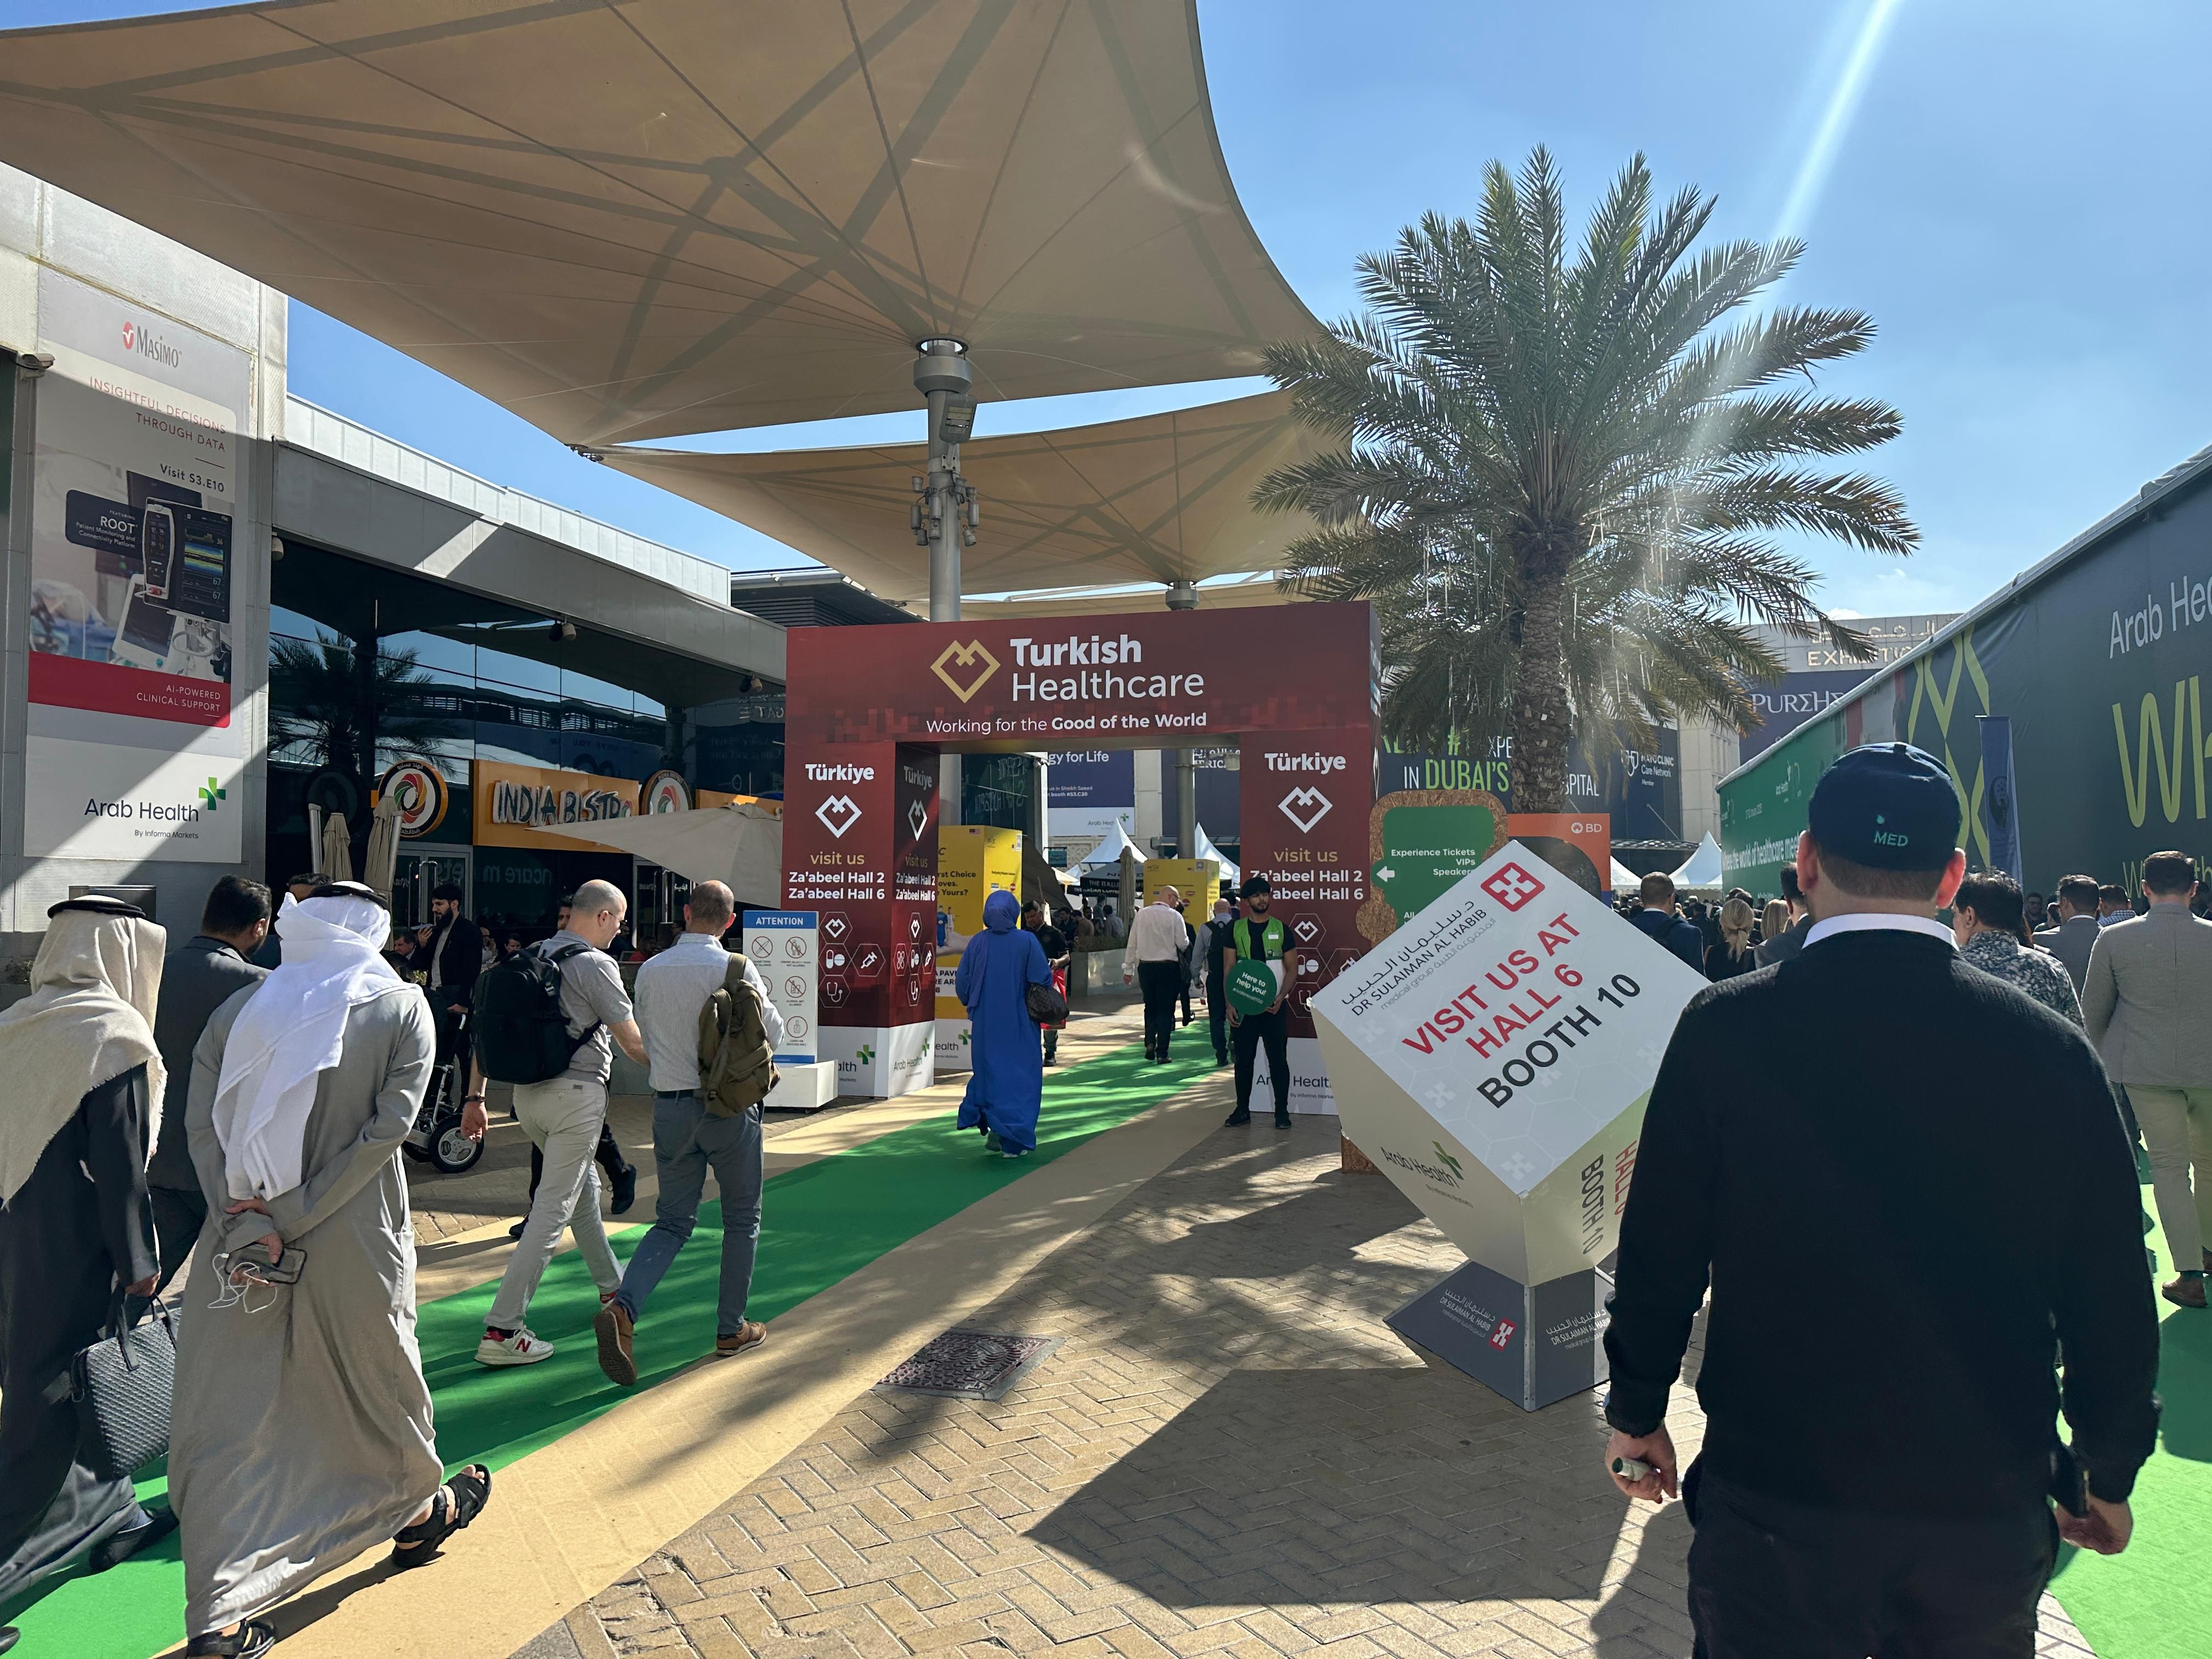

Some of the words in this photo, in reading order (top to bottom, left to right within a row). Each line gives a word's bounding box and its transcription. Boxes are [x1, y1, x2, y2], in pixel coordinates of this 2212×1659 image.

[90, 377, 162, 411] INSIGHTFUL
[167, 405, 225, 434] DECISIONS
[136, 412, 192, 441] THROUGH
[198, 435, 225, 452] DATA
[160, 463, 185, 480] Visit
[189, 473, 224, 492] S3.E10
[100, 516, 135, 534] ROOT
[2109, 594, 2163, 659] Arab
[1010, 634, 1142, 667] Turkish
[166, 685, 221, 700] AI-POWERED
[1012, 669, 1204, 702] Healthcare
[137, 692, 179, 706] CLINICAL
[182, 699, 220, 712] SUPPORT
[926, 719, 991, 735] Working
[996, 718, 1017, 732] for
[1020, 717, 1047, 731] the
[1052, 715, 1095, 730] Good
[1100, 715, 1116, 729] of
[1119, 714, 1150, 728] the
[1154, 713, 1207, 728] World
[1048, 753, 1063, 765] gy
[1066, 751, 1084, 763] for
[1086, 751, 1109, 763] Life
[1264, 752, 1346, 774] Türkiye
[805, 763, 874, 784] Türkiye
[904, 766, 933, 791] Türkiye
[1404, 766, 1419, 789] IN
[1425, 758, 1509, 792] DUBAI'S
[1641, 765, 1654, 775] Care
[84, 798, 133, 818] Arab
[139, 802, 199, 822] Health
[493, 780, 557, 827] INDIA
[145, 830, 171, 838] Informa
[1585, 823, 1602, 833] BD
[1874, 831, 1909, 847] MED
[810, 851, 842, 865] visit
[847, 854, 865, 865] us
[905, 853, 919, 867] visit
[920, 859, 928, 868] us
[1273, 848, 1311, 862] visit
[1317, 851, 1338, 862] us
[1391, 849, 1441, 857] Experience
[789, 871, 844, 883] Za'abeel
[848, 871, 873, 883] Hall
[877, 872, 885, 883] 2
[896, 872, 920, 885] Za'abeel
[921, 874, 932, 885] Hall
[932, 876, 935, 886] 2
[1319, 870, 1348, 882] Hall
[1353, 870, 1363, 882] 2
[788, 888, 844, 899] Za'abeel
[848, 888, 873, 899] Hall
[877, 888, 885, 899] 6
[895, 889, 919, 901] Za'abeel
[920, 890, 931, 901] Hall
[931, 890, 935, 901] 6
[1319, 888, 1349, 900] Hall
[1353, 888, 1364, 900] 6
[756, 917, 804, 926] ATTENTION
[1397, 909, 1463, 963] سليمان
[1351, 999, 1373, 1016] DR
[1371, 949, 1435, 1002] SULAIMAN
[1434, 939, 1452, 953] AL
[1449, 909, 1487, 940] HABIB
[1236, 978, 1251, 989] help
[1251, 985, 1267, 996] you!
[1242, 972, 1257, 984] Here
[1258, 979, 1266, 987] to
[1341, 958, 1398, 1005] الحبيب
[1380, 984, 1411, 1011] medical
[1410, 967, 1435, 988] group
[1402, 984, 1489, 1055] VISIT
[1485, 948, 1541, 992] US
[1536, 912, 1581, 958] AT
[1465, 985, 1563, 1059] HALL
[1554, 962, 1584, 991] 6
[935, 1042, 958, 1051] ealth
[1476, 1005, 1602, 1109] BOOTH
[1597, 973, 1641, 1009] 10
[1293, 1075, 1332, 1087] Healt
[1380, 1146, 1414, 1171] Arab
[1409, 1157, 1460, 1189] Health
[1615, 1140, 1638, 1204] HALL
[1581, 1154, 1604, 1234] BOOTH
[1582, 1226, 1604, 1255] 10
[1439, 1296, 1448, 1306] DR
[1446, 1299, 1471, 1319] SULAIMAN
[1468, 1314, 1476, 1323] AL
[1475, 1317, 1492, 1331] HABIB
[1550, 1336, 1562, 1346] DR
[1560, 1325, 1590, 1342] SULAIMAN
[1588, 1323, 1597, 1331] AL
